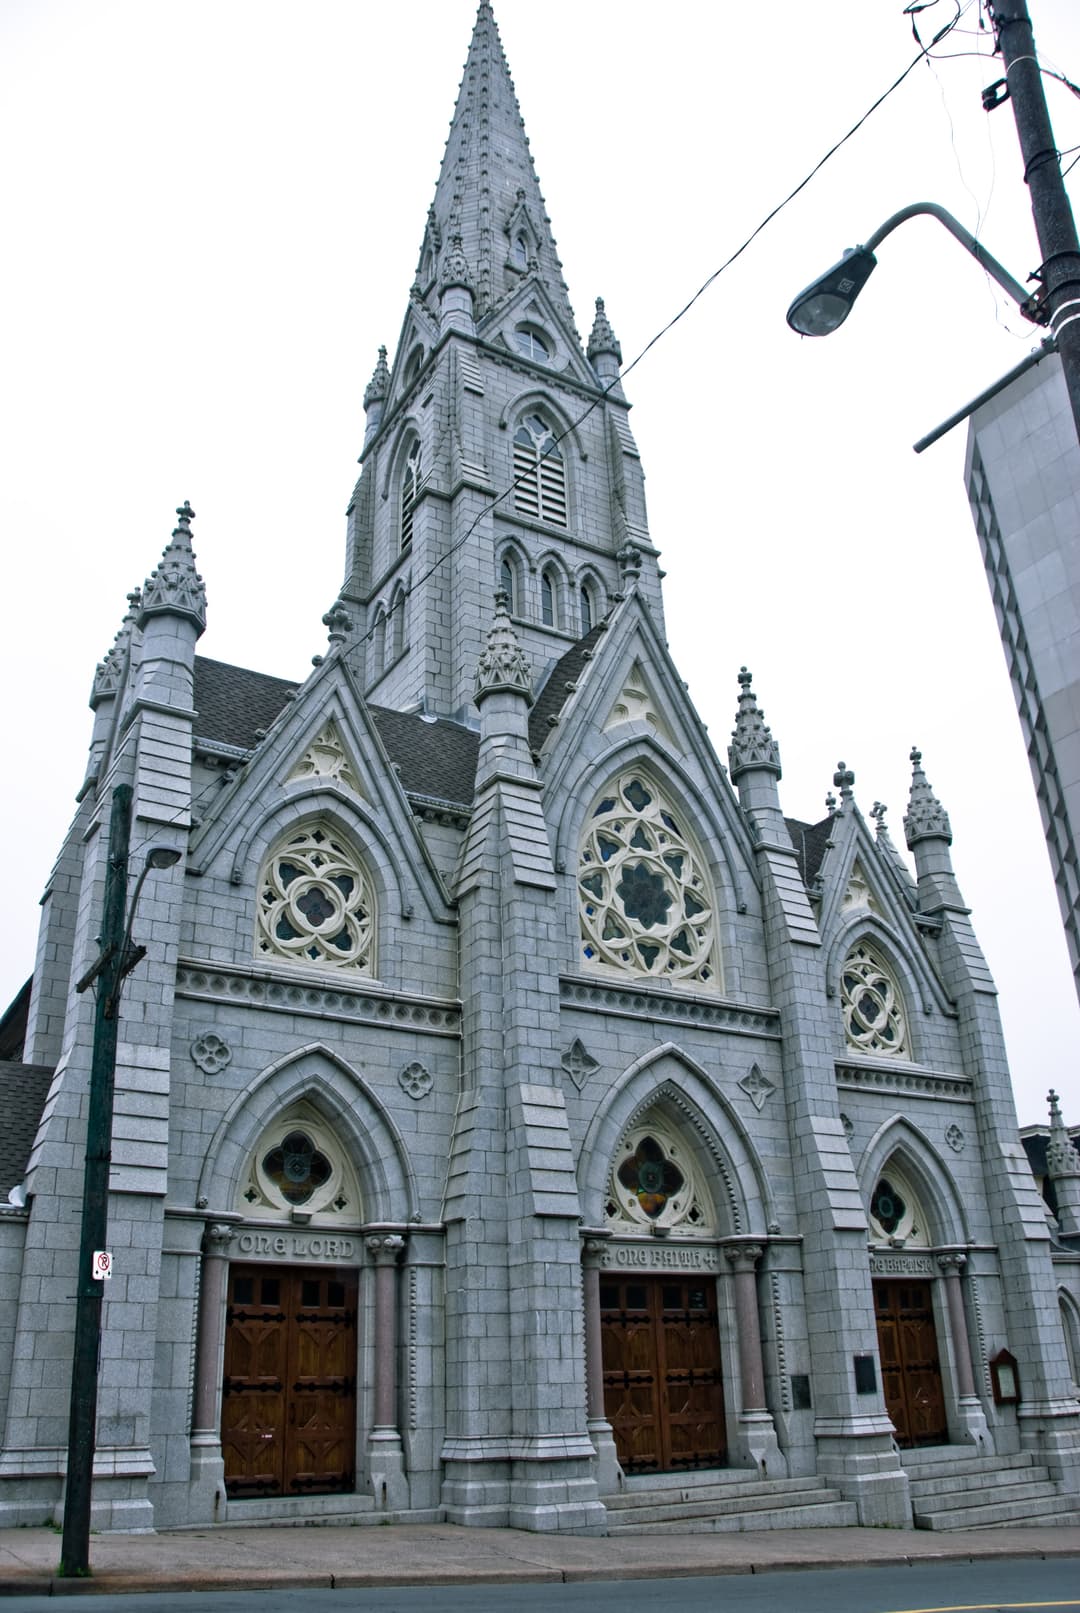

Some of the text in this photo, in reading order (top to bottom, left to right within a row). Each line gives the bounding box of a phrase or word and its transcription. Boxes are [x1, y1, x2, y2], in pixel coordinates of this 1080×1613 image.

[293, 1238, 354, 1257] LORD
[651, 1249, 701, 1268] FAITH
[886, 1258, 933, 1273] BAPTISM
